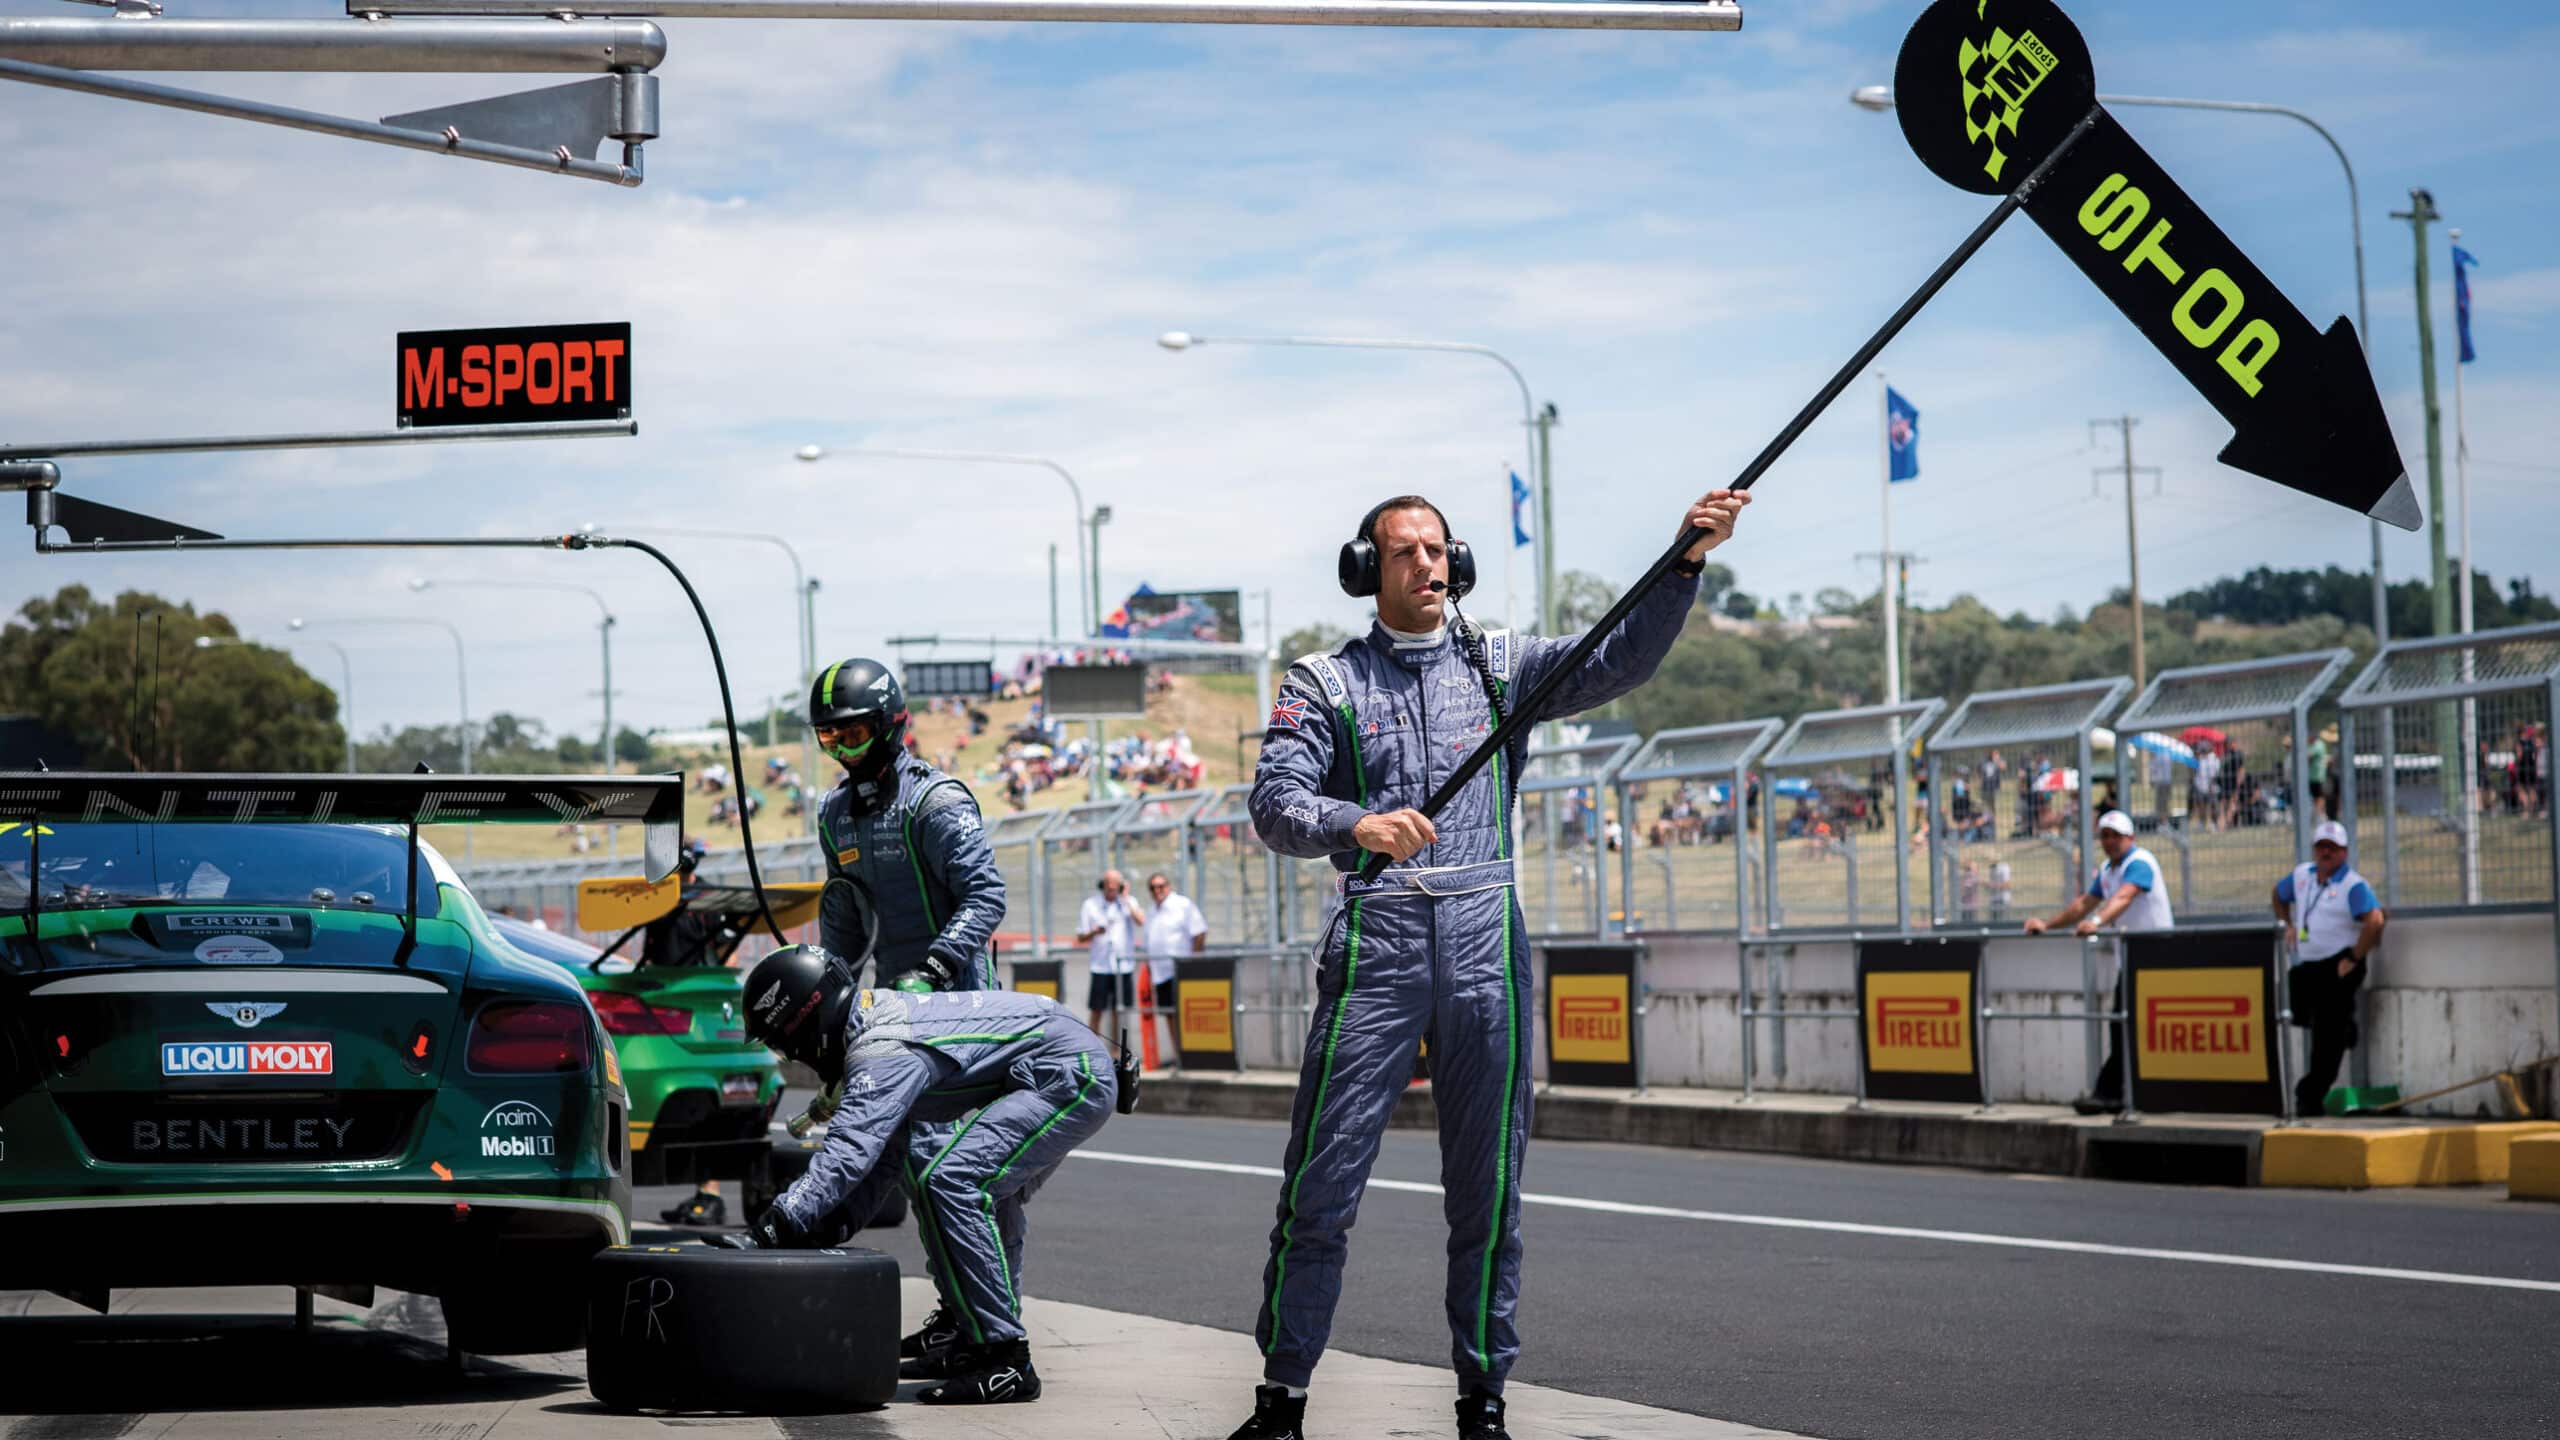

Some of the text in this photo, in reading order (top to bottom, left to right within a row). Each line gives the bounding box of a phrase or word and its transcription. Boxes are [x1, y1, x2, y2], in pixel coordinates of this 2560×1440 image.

[2021, 34, 2056, 67] SPORT
[2078, 173, 2281, 398] STOP
[404, 339, 625, 409] M-SPORT
[191, 916, 270, 926] CREWE
[1877, 997, 1961, 1048] PIRELLI
[2147, 997, 2250, 1053] PIRELLI
[167, 1046, 329, 1071] LIQUI MOLY
[133, 1118, 355, 1149] BENTLEY
[496, 1109, 537, 1126] naim
[481, 1136, 535, 1156] Mobil
[611, 1275, 674, 1344] FR
